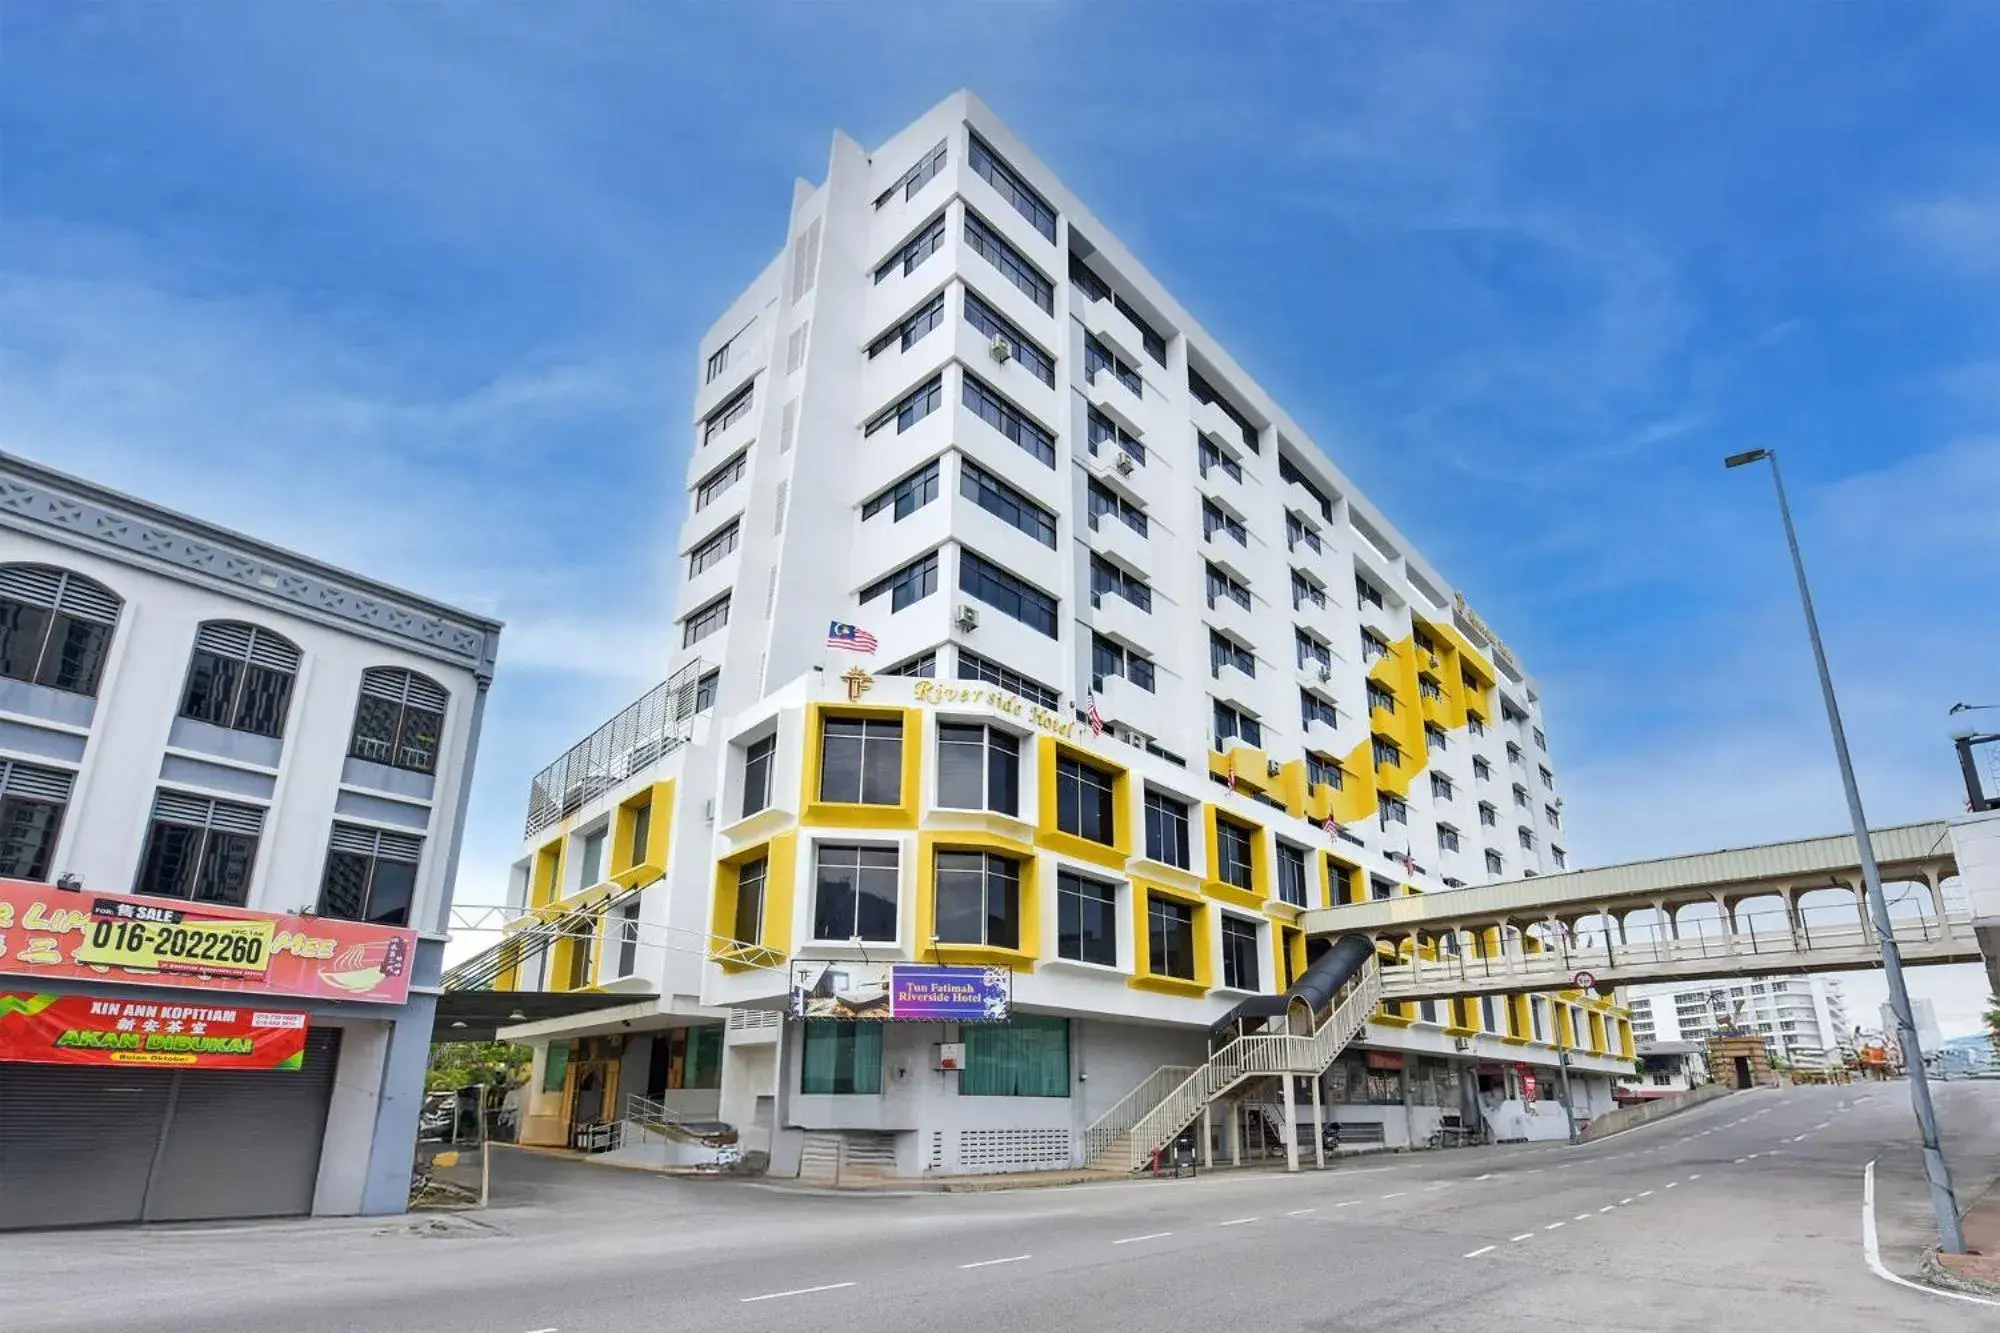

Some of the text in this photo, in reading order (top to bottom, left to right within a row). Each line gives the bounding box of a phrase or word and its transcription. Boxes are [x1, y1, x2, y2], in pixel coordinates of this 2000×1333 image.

[136, 906, 173, 922] SALE
[93, 919, 262, 964] 016-2022260
[906, 983, 974, 993] Tun Fatimah
[898, 992, 981, 1003] Riverside Hotel
[91, 1001, 236, 1022] XIN ANN KOPITIAM
[57, 1029, 140, 1049] AKAN
